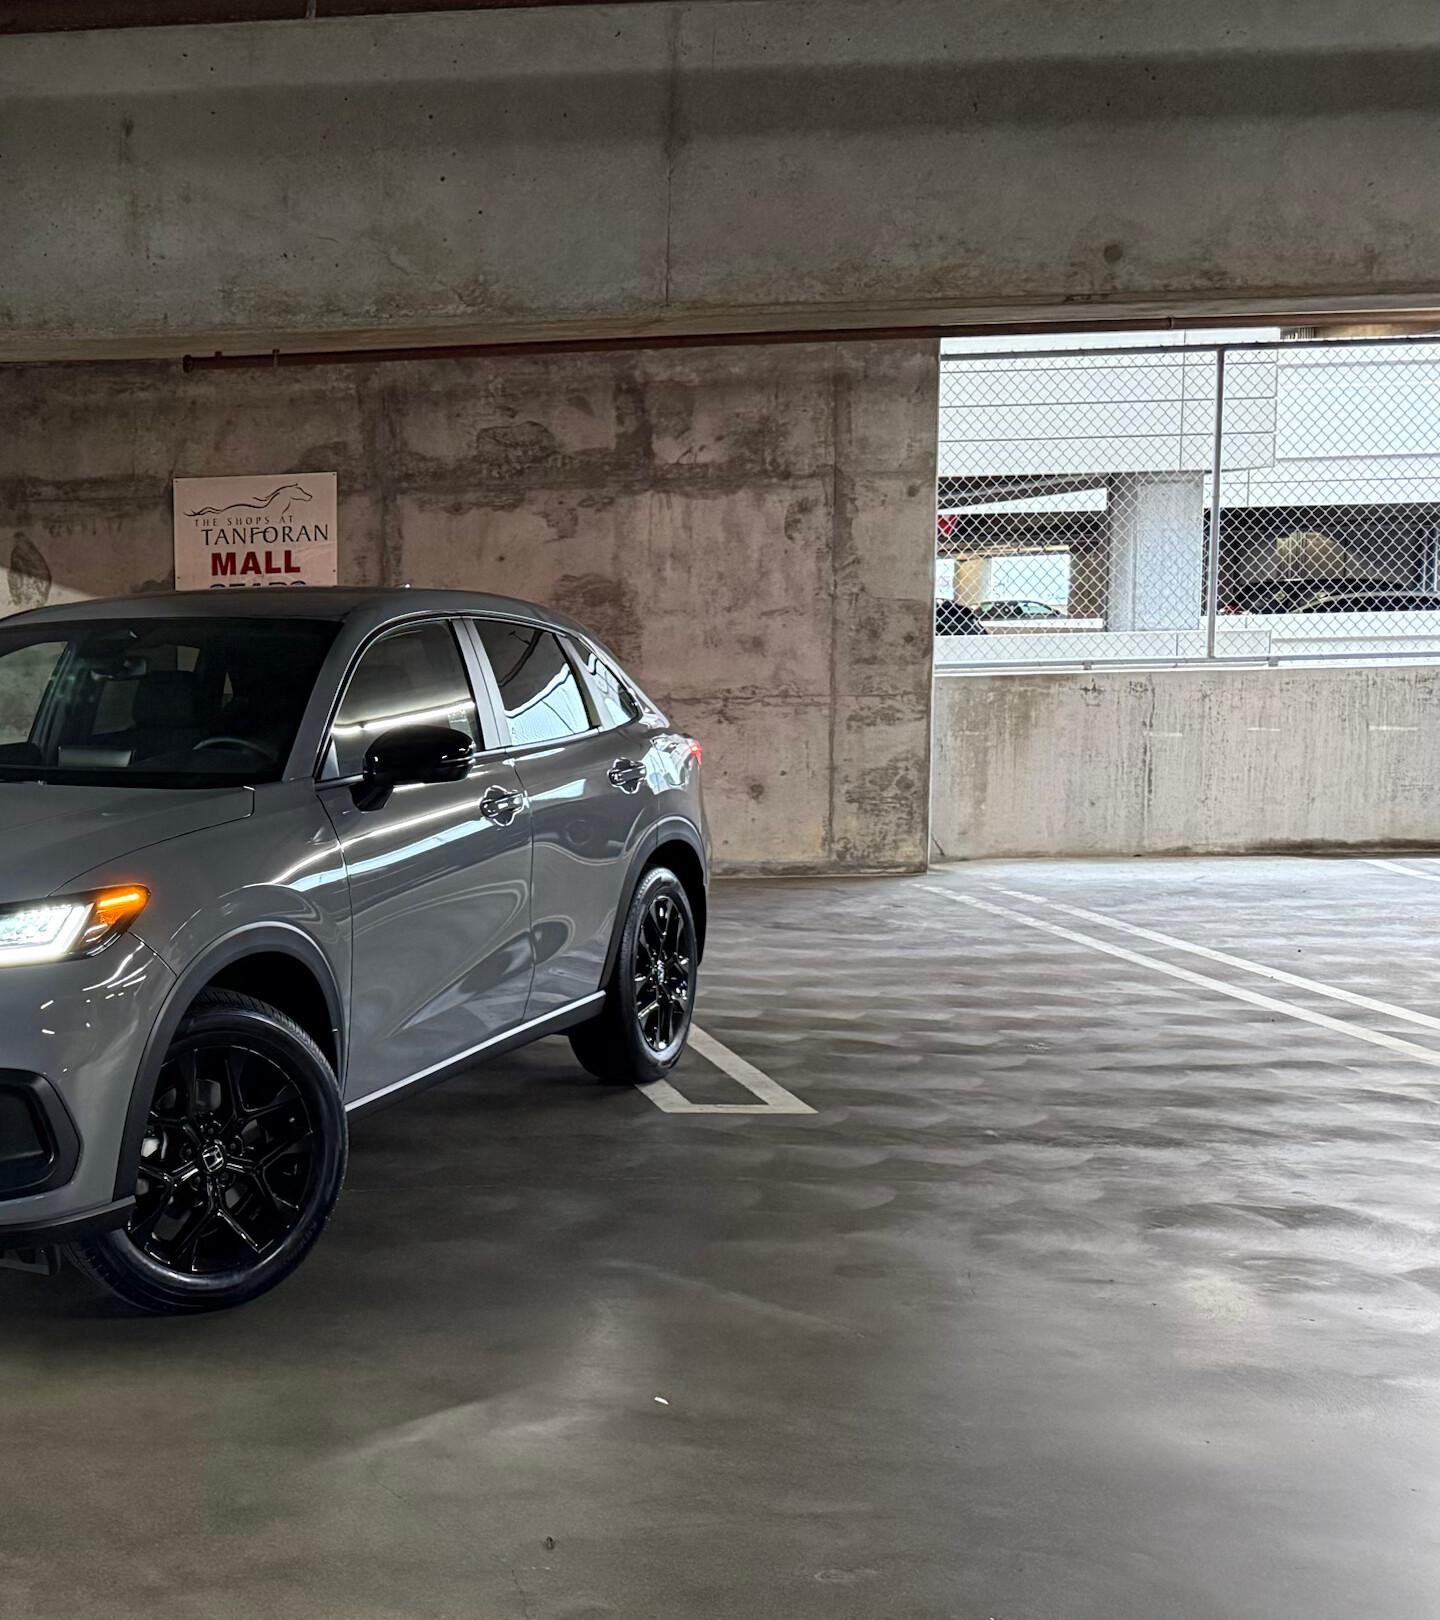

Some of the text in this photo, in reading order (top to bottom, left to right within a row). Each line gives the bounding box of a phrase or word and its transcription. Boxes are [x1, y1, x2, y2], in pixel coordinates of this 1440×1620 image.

[195, 515, 293, 527] THE SHOPS AT
[201, 524, 328, 546] TANFORAN
[212, 550, 301, 576] MALL
